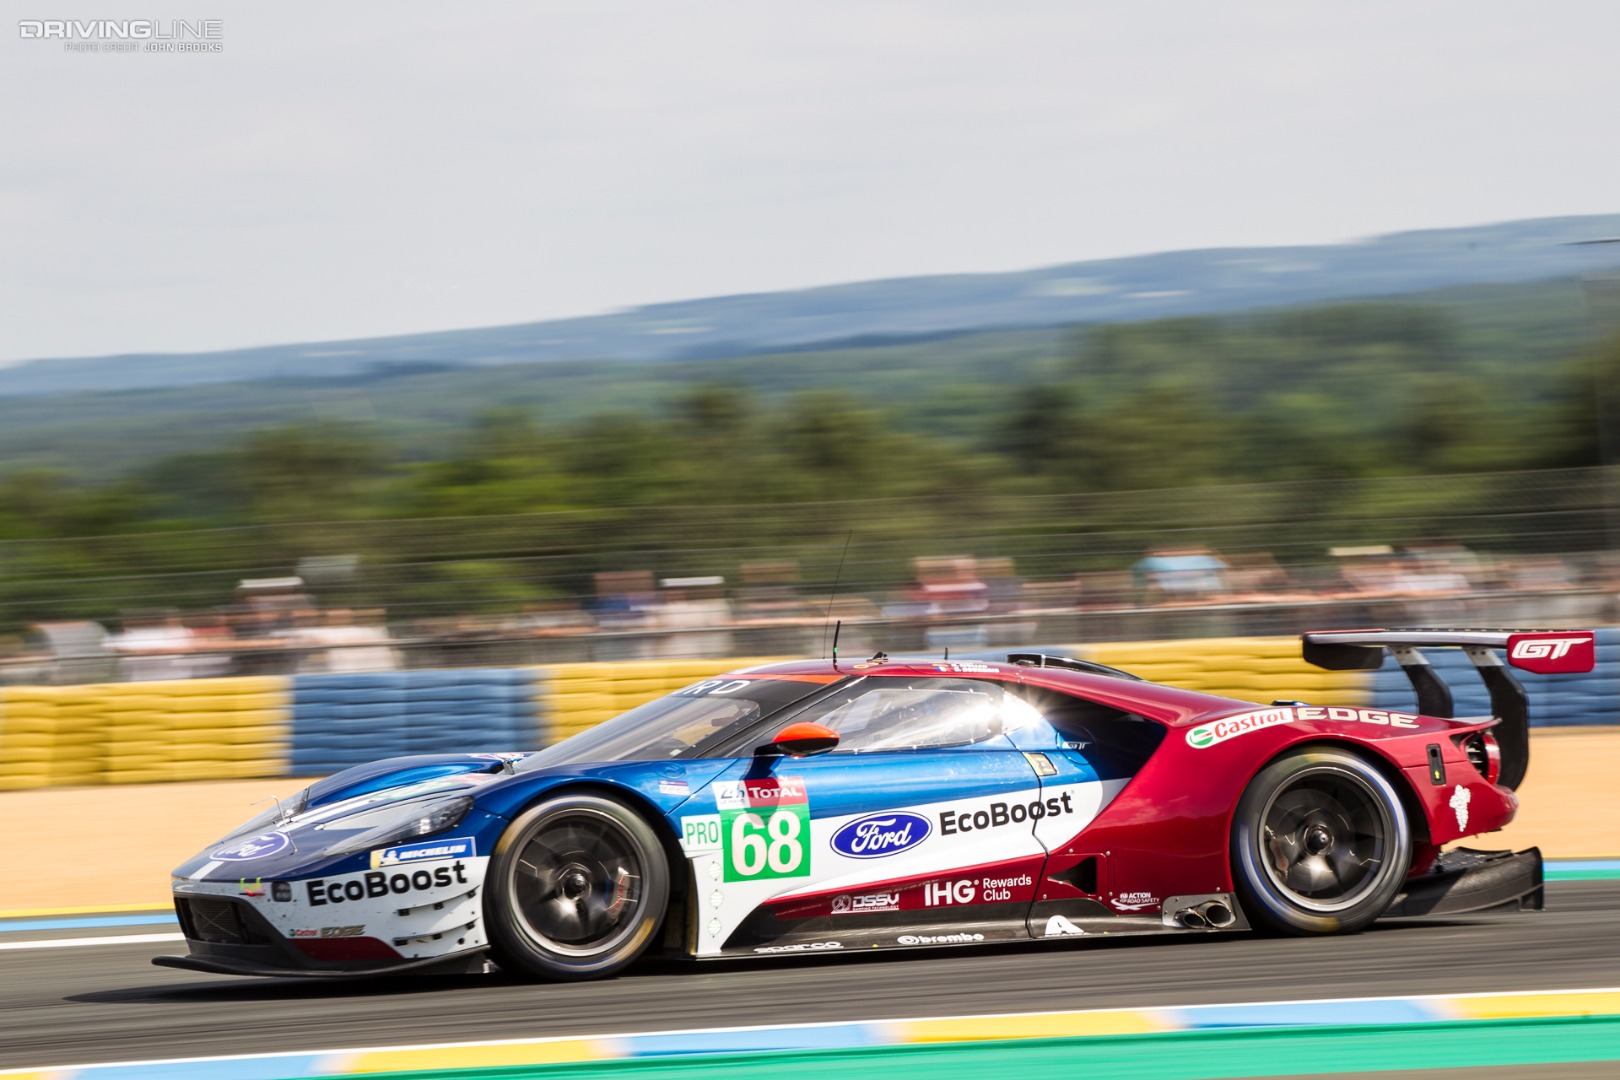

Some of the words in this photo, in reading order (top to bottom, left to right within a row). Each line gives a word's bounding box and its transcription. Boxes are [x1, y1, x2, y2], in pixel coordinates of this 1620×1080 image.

[1511, 637, 1593, 660] GT
[1214, 708, 1286, 739] Castrol
[1296, 707, 1420, 729] EDGE
[939, 791, 1074, 836] EcoBoost
[685, 820, 719, 845] PRO
[731, 810, 803, 876] 68
[851, 818, 912, 853] Ford
[399, 845, 467, 860] MICHELIN
[306, 860, 468, 907] EcoBoost
[924, 880, 976, 906] IHG
[982, 875, 1032, 889] Rewards
[852, 893, 900, 907] DSSV
[983, 889, 1011, 901] Club
[296, 928, 318, 936] Castrol
[320, 925, 366, 938] EDGE
[919, 933, 985, 944] brembo
